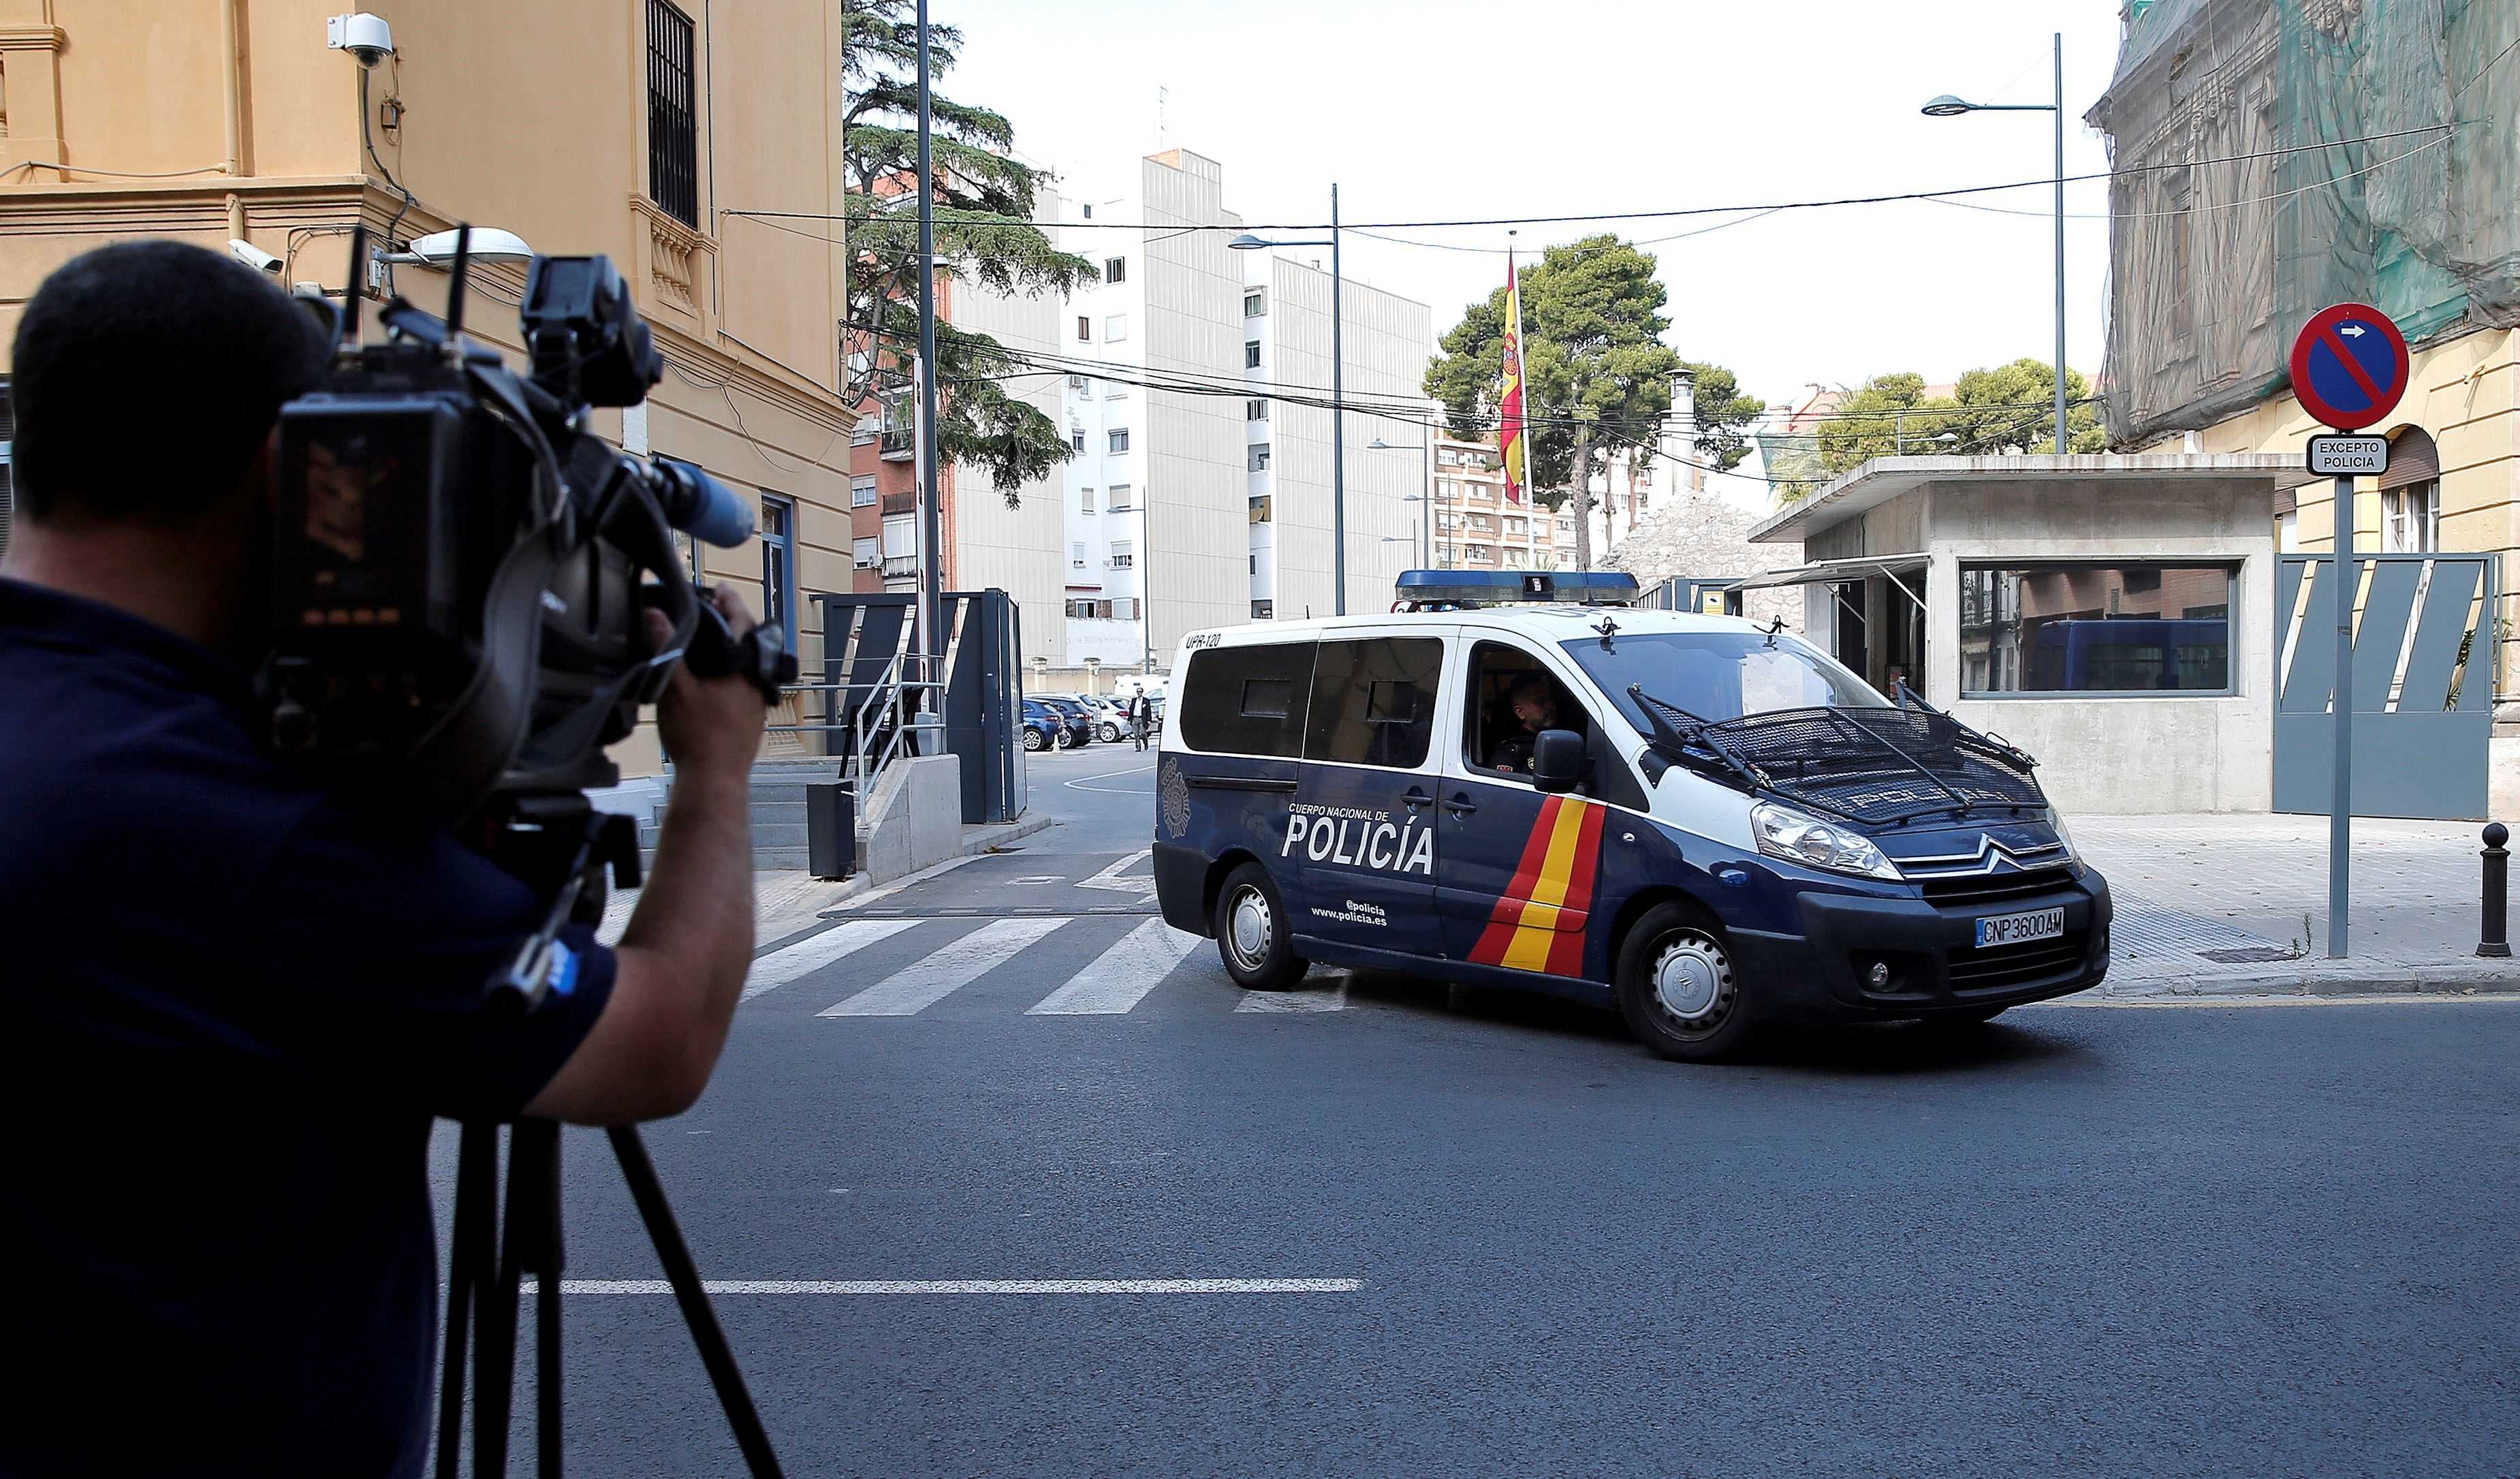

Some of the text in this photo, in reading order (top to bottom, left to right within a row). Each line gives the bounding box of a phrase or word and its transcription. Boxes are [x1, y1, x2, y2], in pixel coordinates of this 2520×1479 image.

[2320, 442, 2379, 453] EXCEPTO
[2324, 457, 2375, 467] POLICIA
[1186, 633, 1221, 649] UPR-120
[1289, 803, 1389, 822] CUERPO NACIONAL DE
[1281, 814, 1433, 875] POLICÍA
[1346, 899, 1385, 916] @policia
[1311, 907, 1387, 927] www.policia.es
